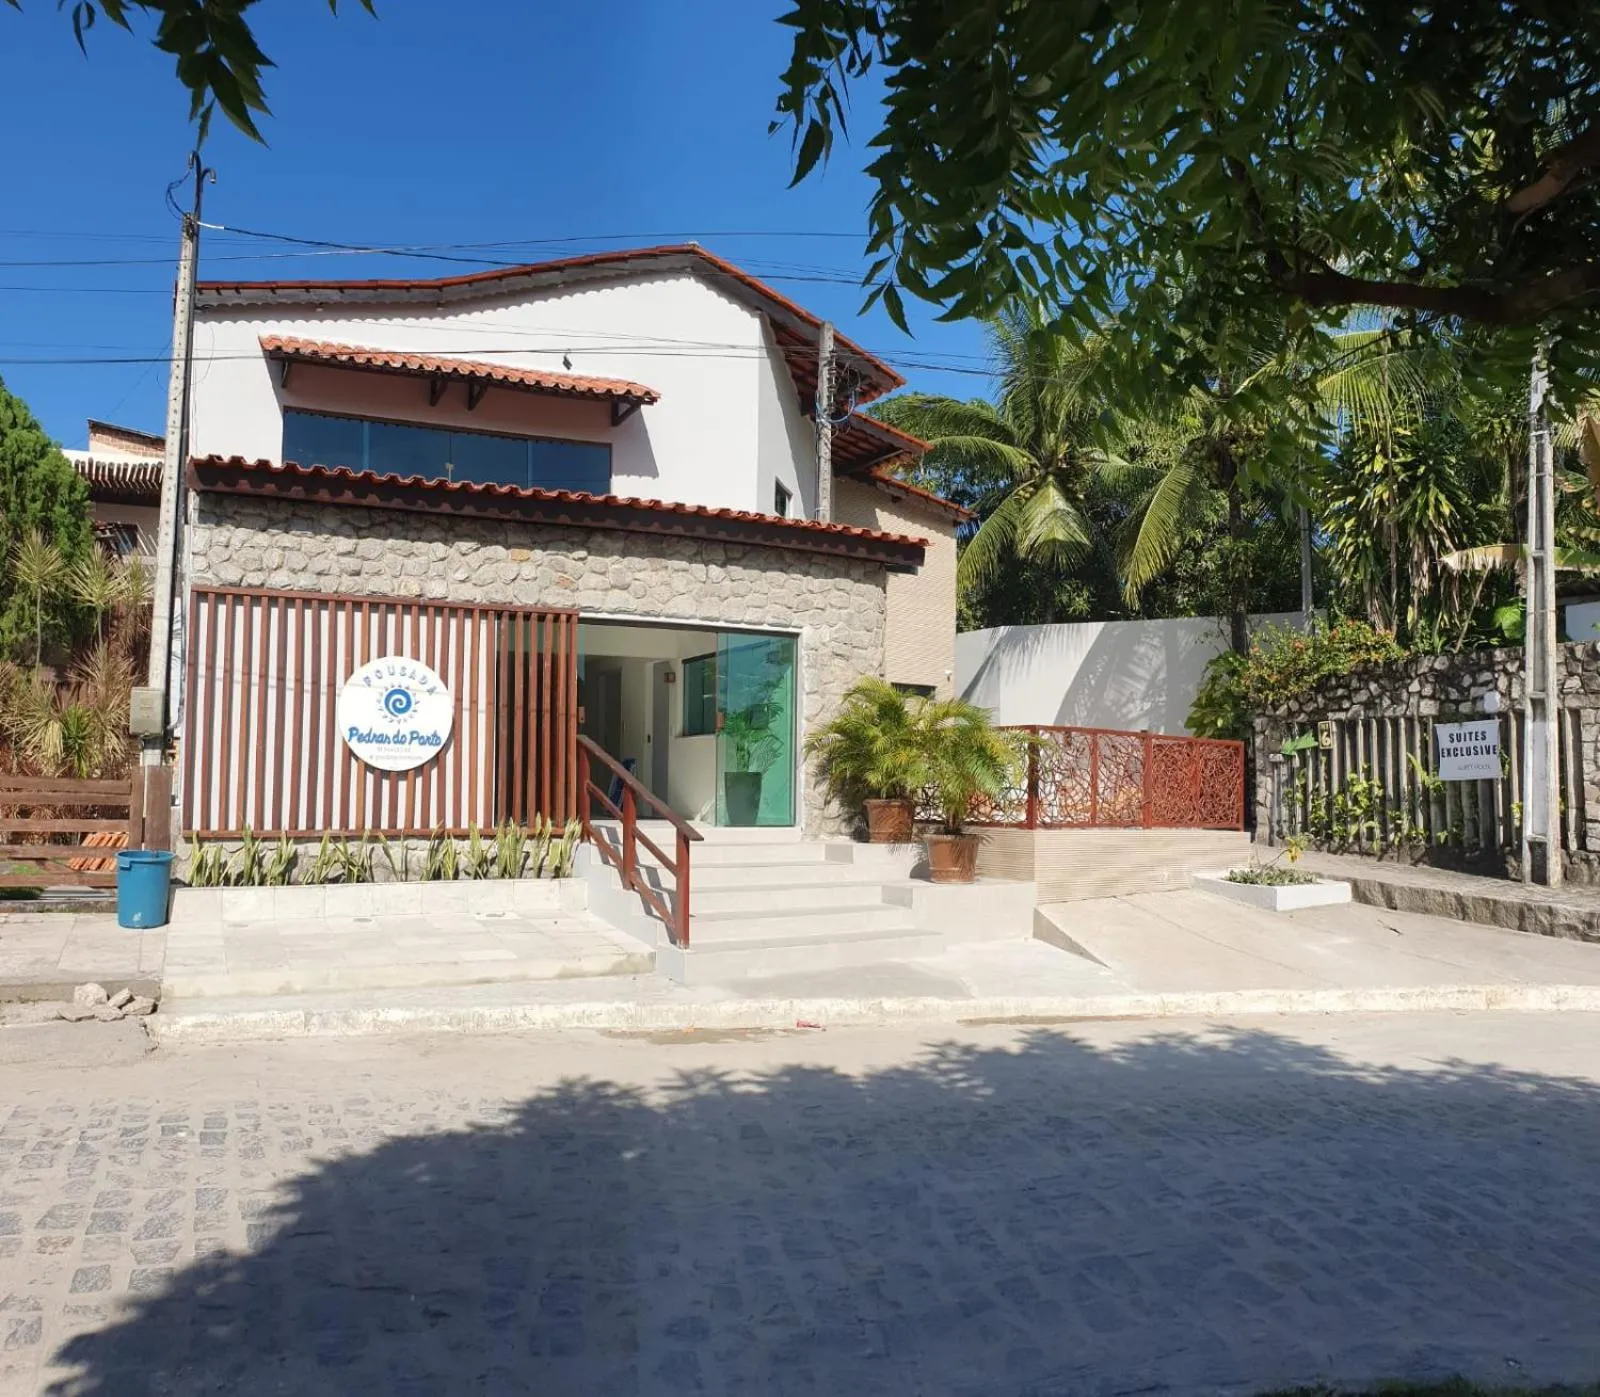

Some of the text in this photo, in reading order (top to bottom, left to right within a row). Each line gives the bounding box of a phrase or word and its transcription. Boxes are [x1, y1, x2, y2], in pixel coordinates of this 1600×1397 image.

[363, 665, 438, 695] POUSADA
[392, 729, 406, 745] do
[1448, 730, 1487, 744] SUITES
[1441, 744, 1497, 758] EXCLUSIVE
